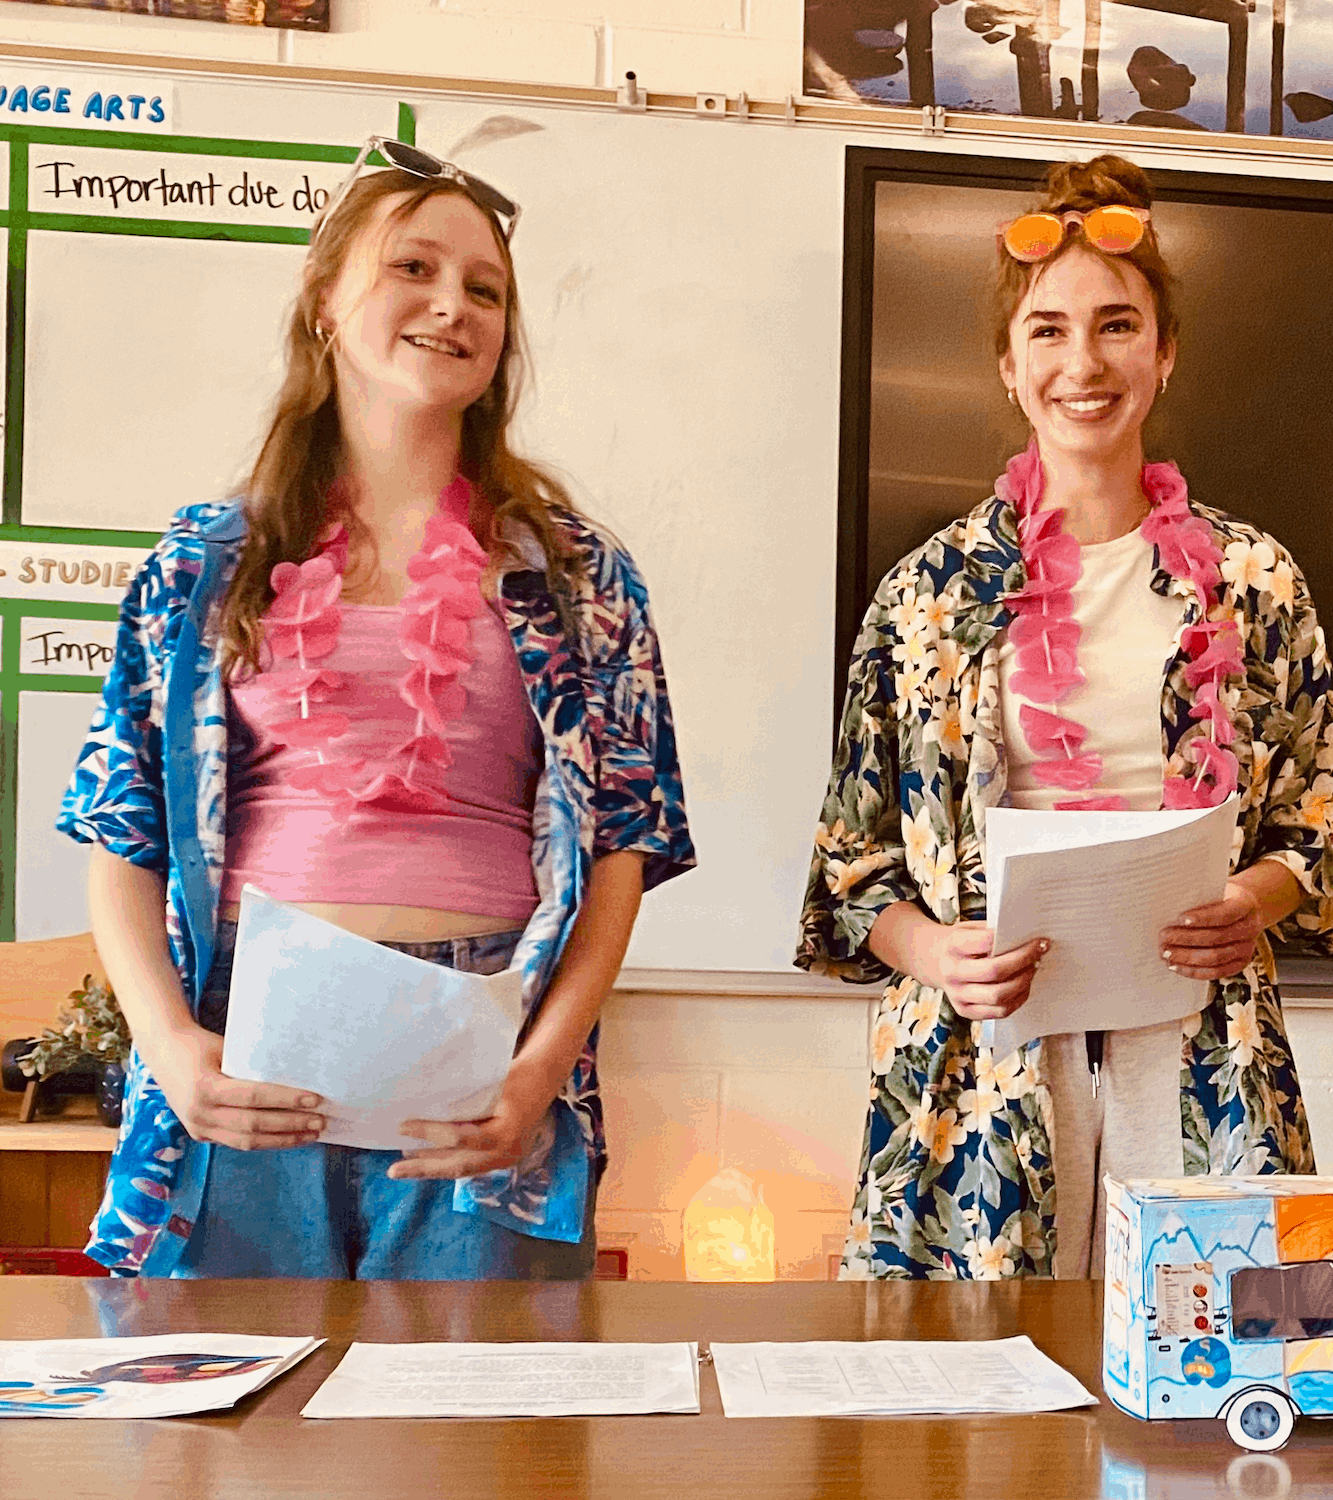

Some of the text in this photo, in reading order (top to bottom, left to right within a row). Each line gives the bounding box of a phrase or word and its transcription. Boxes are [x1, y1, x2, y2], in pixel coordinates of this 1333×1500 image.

[83, 91, 165, 123] ARTS
[35, 161, 223, 209] Important
[228, 171, 285, 209] due
[18, 556, 141, 588] STUDIE
[26, 631, 116, 671] Impo
